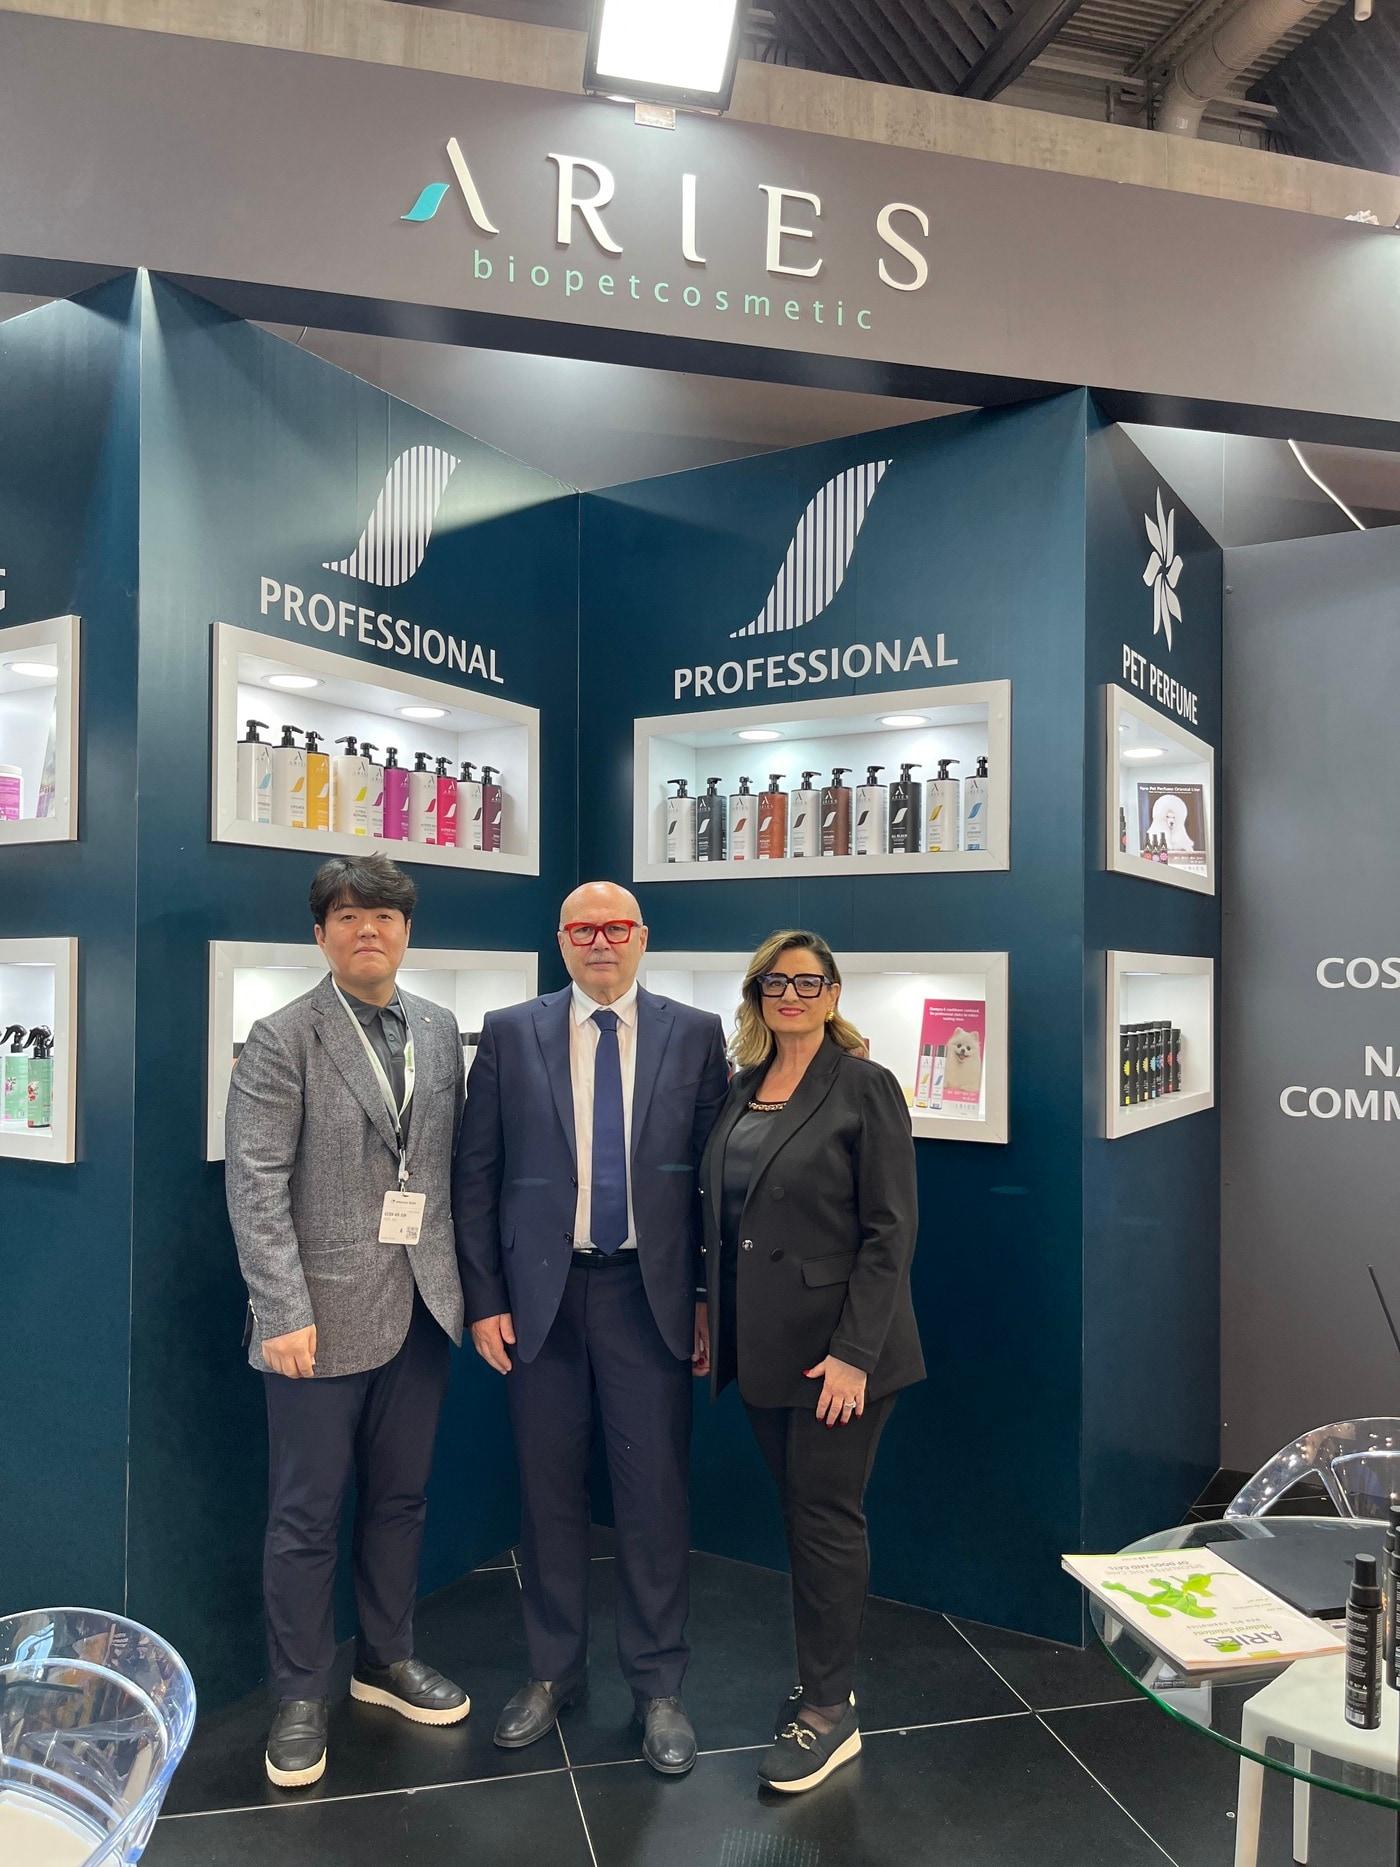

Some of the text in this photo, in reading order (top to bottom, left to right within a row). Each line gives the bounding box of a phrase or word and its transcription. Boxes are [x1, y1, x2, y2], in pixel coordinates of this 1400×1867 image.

[401, 136, 929, 291] ARIES
[473, 250, 872, 329] biopetcosmetic
[260, 576, 505, 684] PROFESSIONAL
[674, 633, 958, 700] PROFESSIONAL
[1122, 643, 1199, 726] PET PERFUME
[1316, 957, 1400, 989] COS
[1364, 1045, 1400, 1077] N
[1203, 1630, 1283, 1648] ARIES
